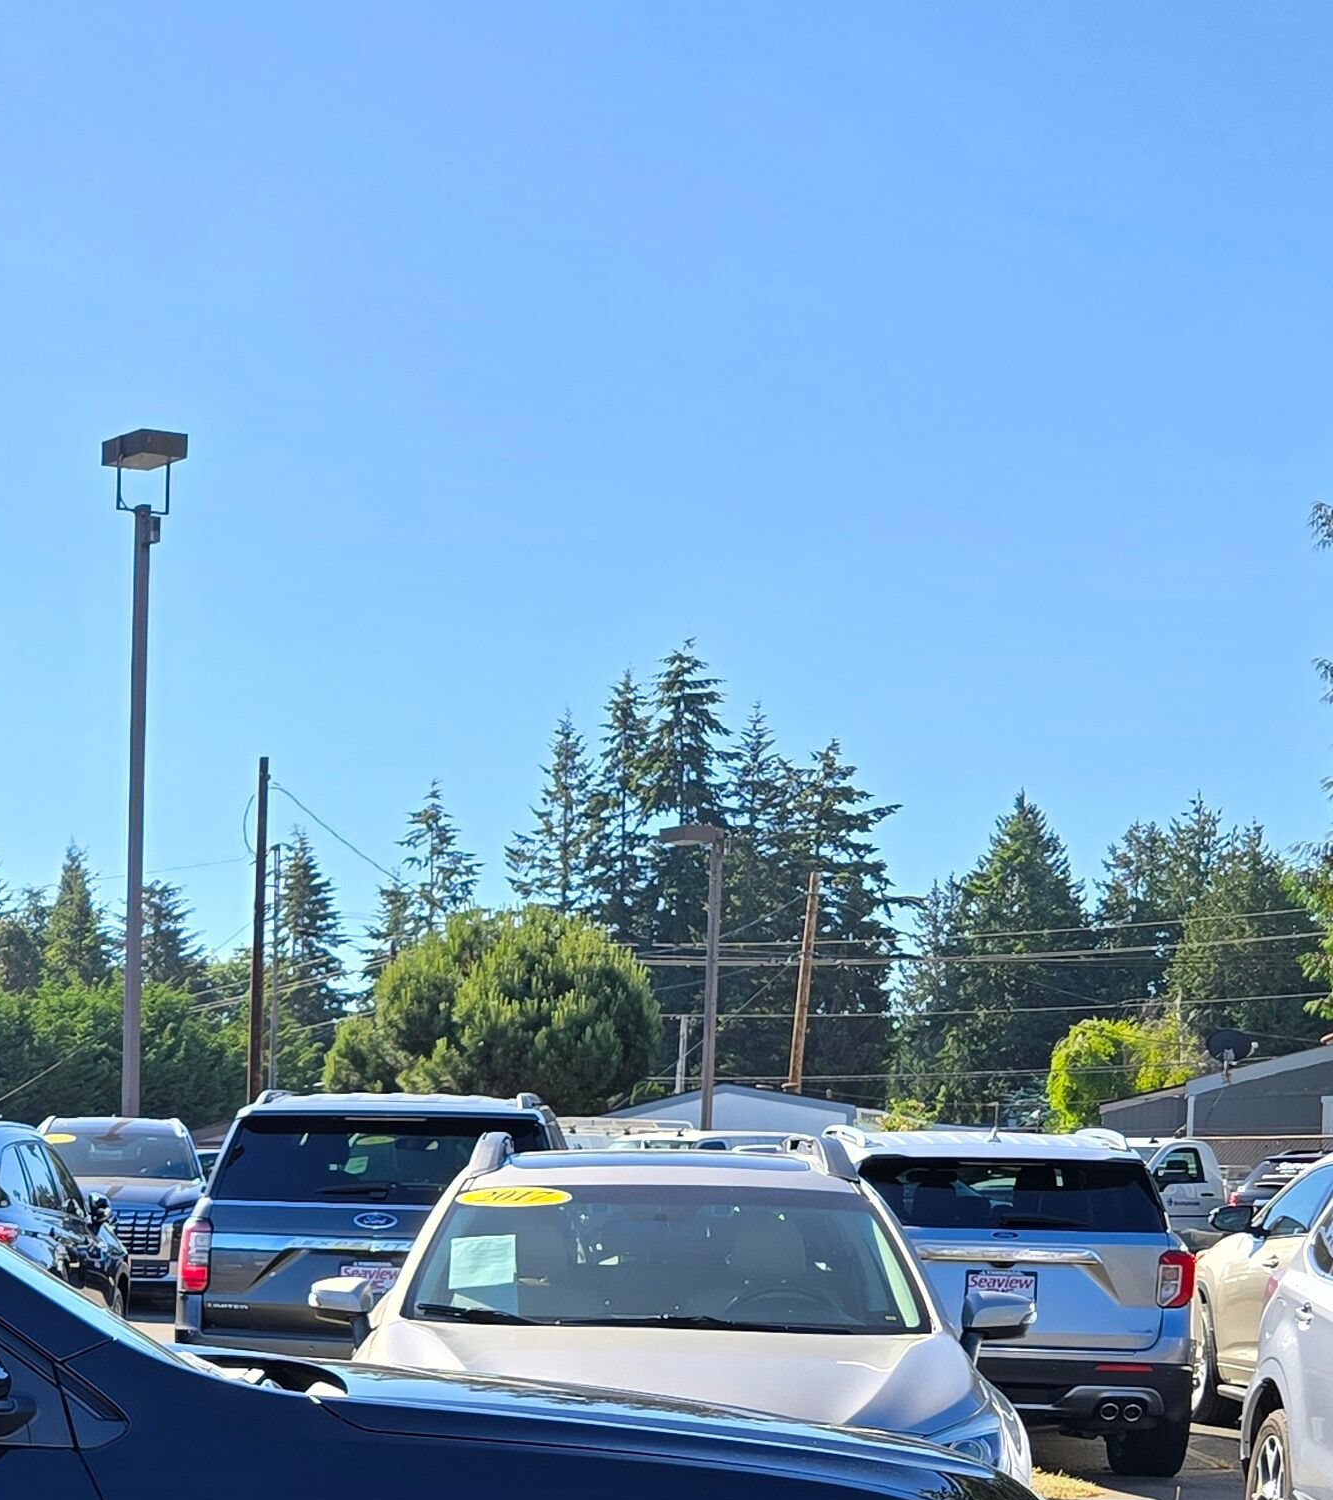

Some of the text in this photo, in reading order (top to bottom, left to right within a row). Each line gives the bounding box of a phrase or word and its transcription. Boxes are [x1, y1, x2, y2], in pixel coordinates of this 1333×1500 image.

[473, 1189, 555, 1202] 2017
[343, 1266, 400, 1280] Seaview
[968, 1274, 1034, 1289] Seaview
